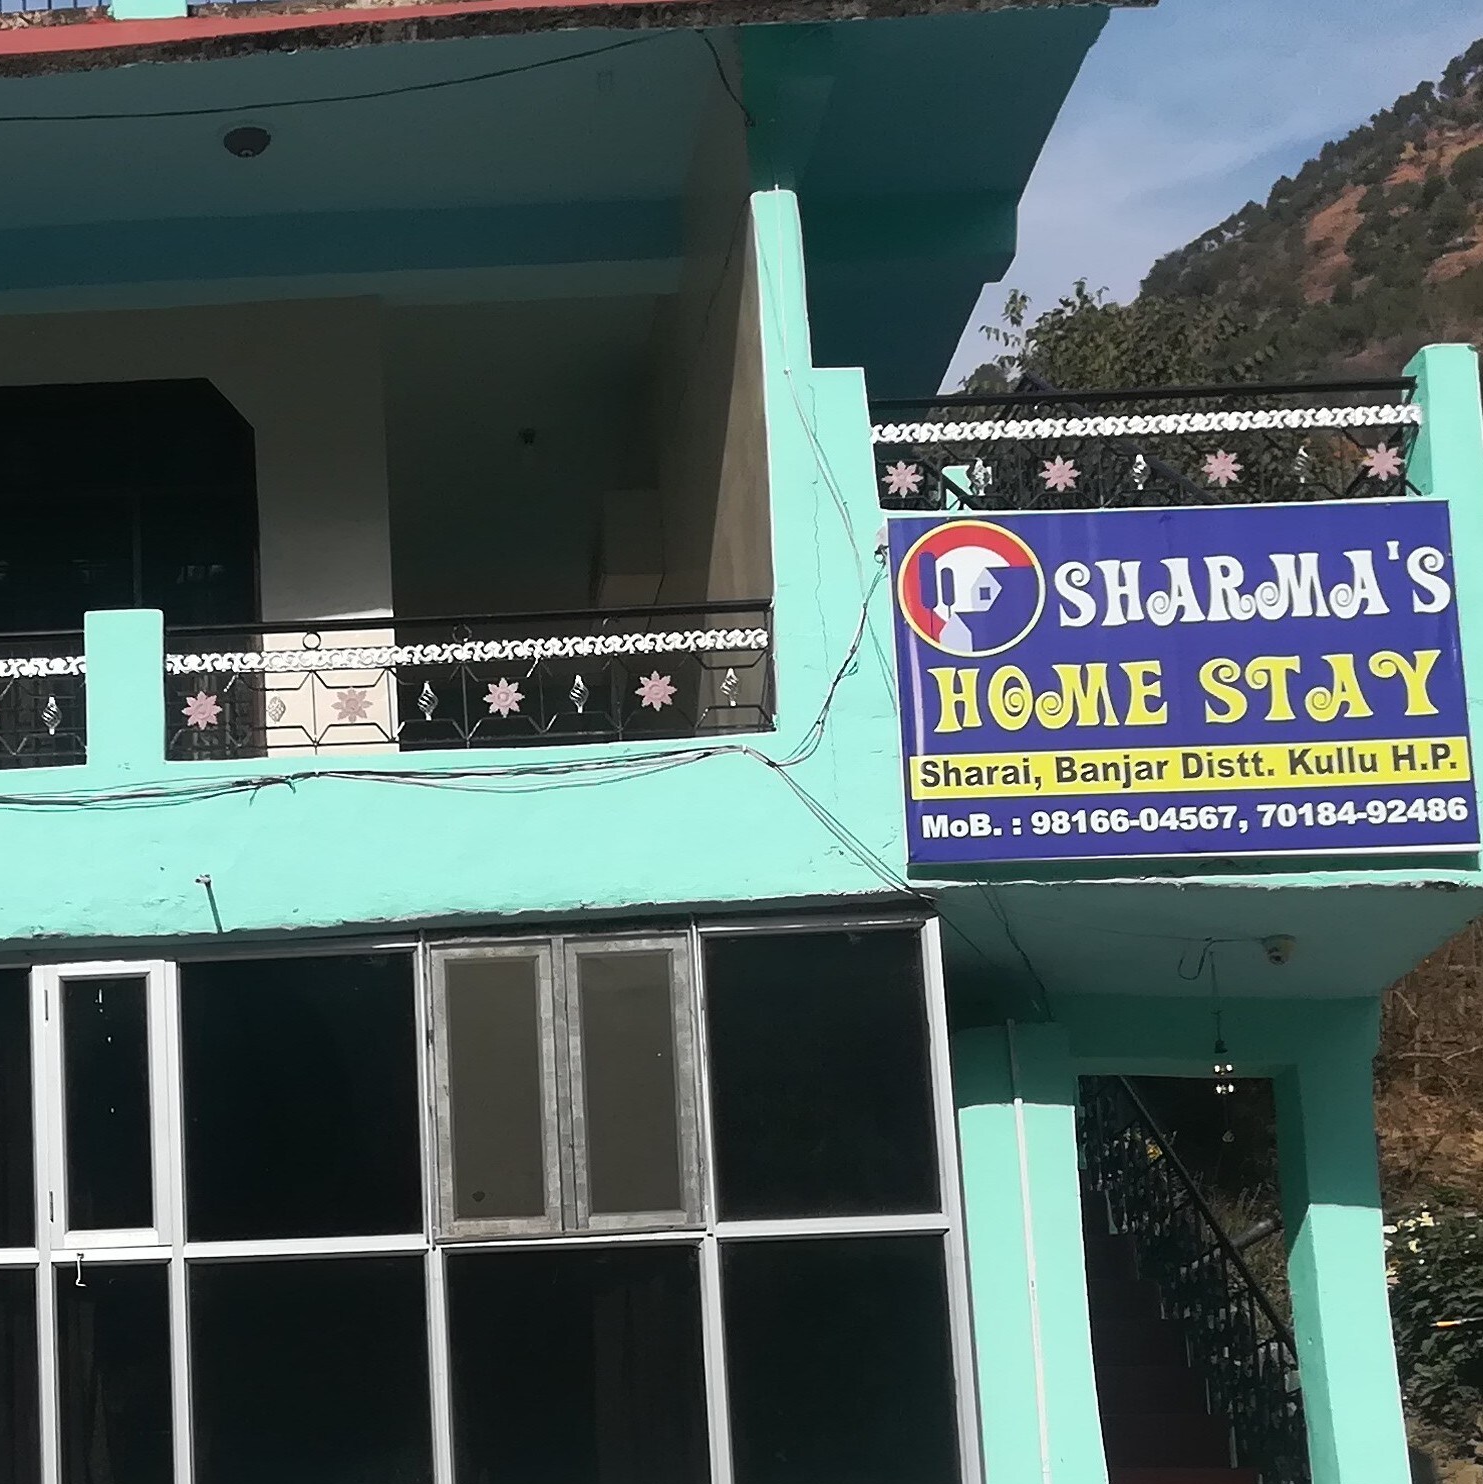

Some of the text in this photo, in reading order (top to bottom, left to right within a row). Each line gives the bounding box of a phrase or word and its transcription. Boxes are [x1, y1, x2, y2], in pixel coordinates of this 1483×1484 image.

[1053, 540, 1453, 628] SHARMA'S
[927, 649, 1442, 734] HOME STAY
[920, 742, 1458, 791] Sharai, Banjar Distt. Kullu H.P.
[1030, 805, 1249, 835] 98166-04567,
[1256, 797, 1469, 828] 70184-92486
